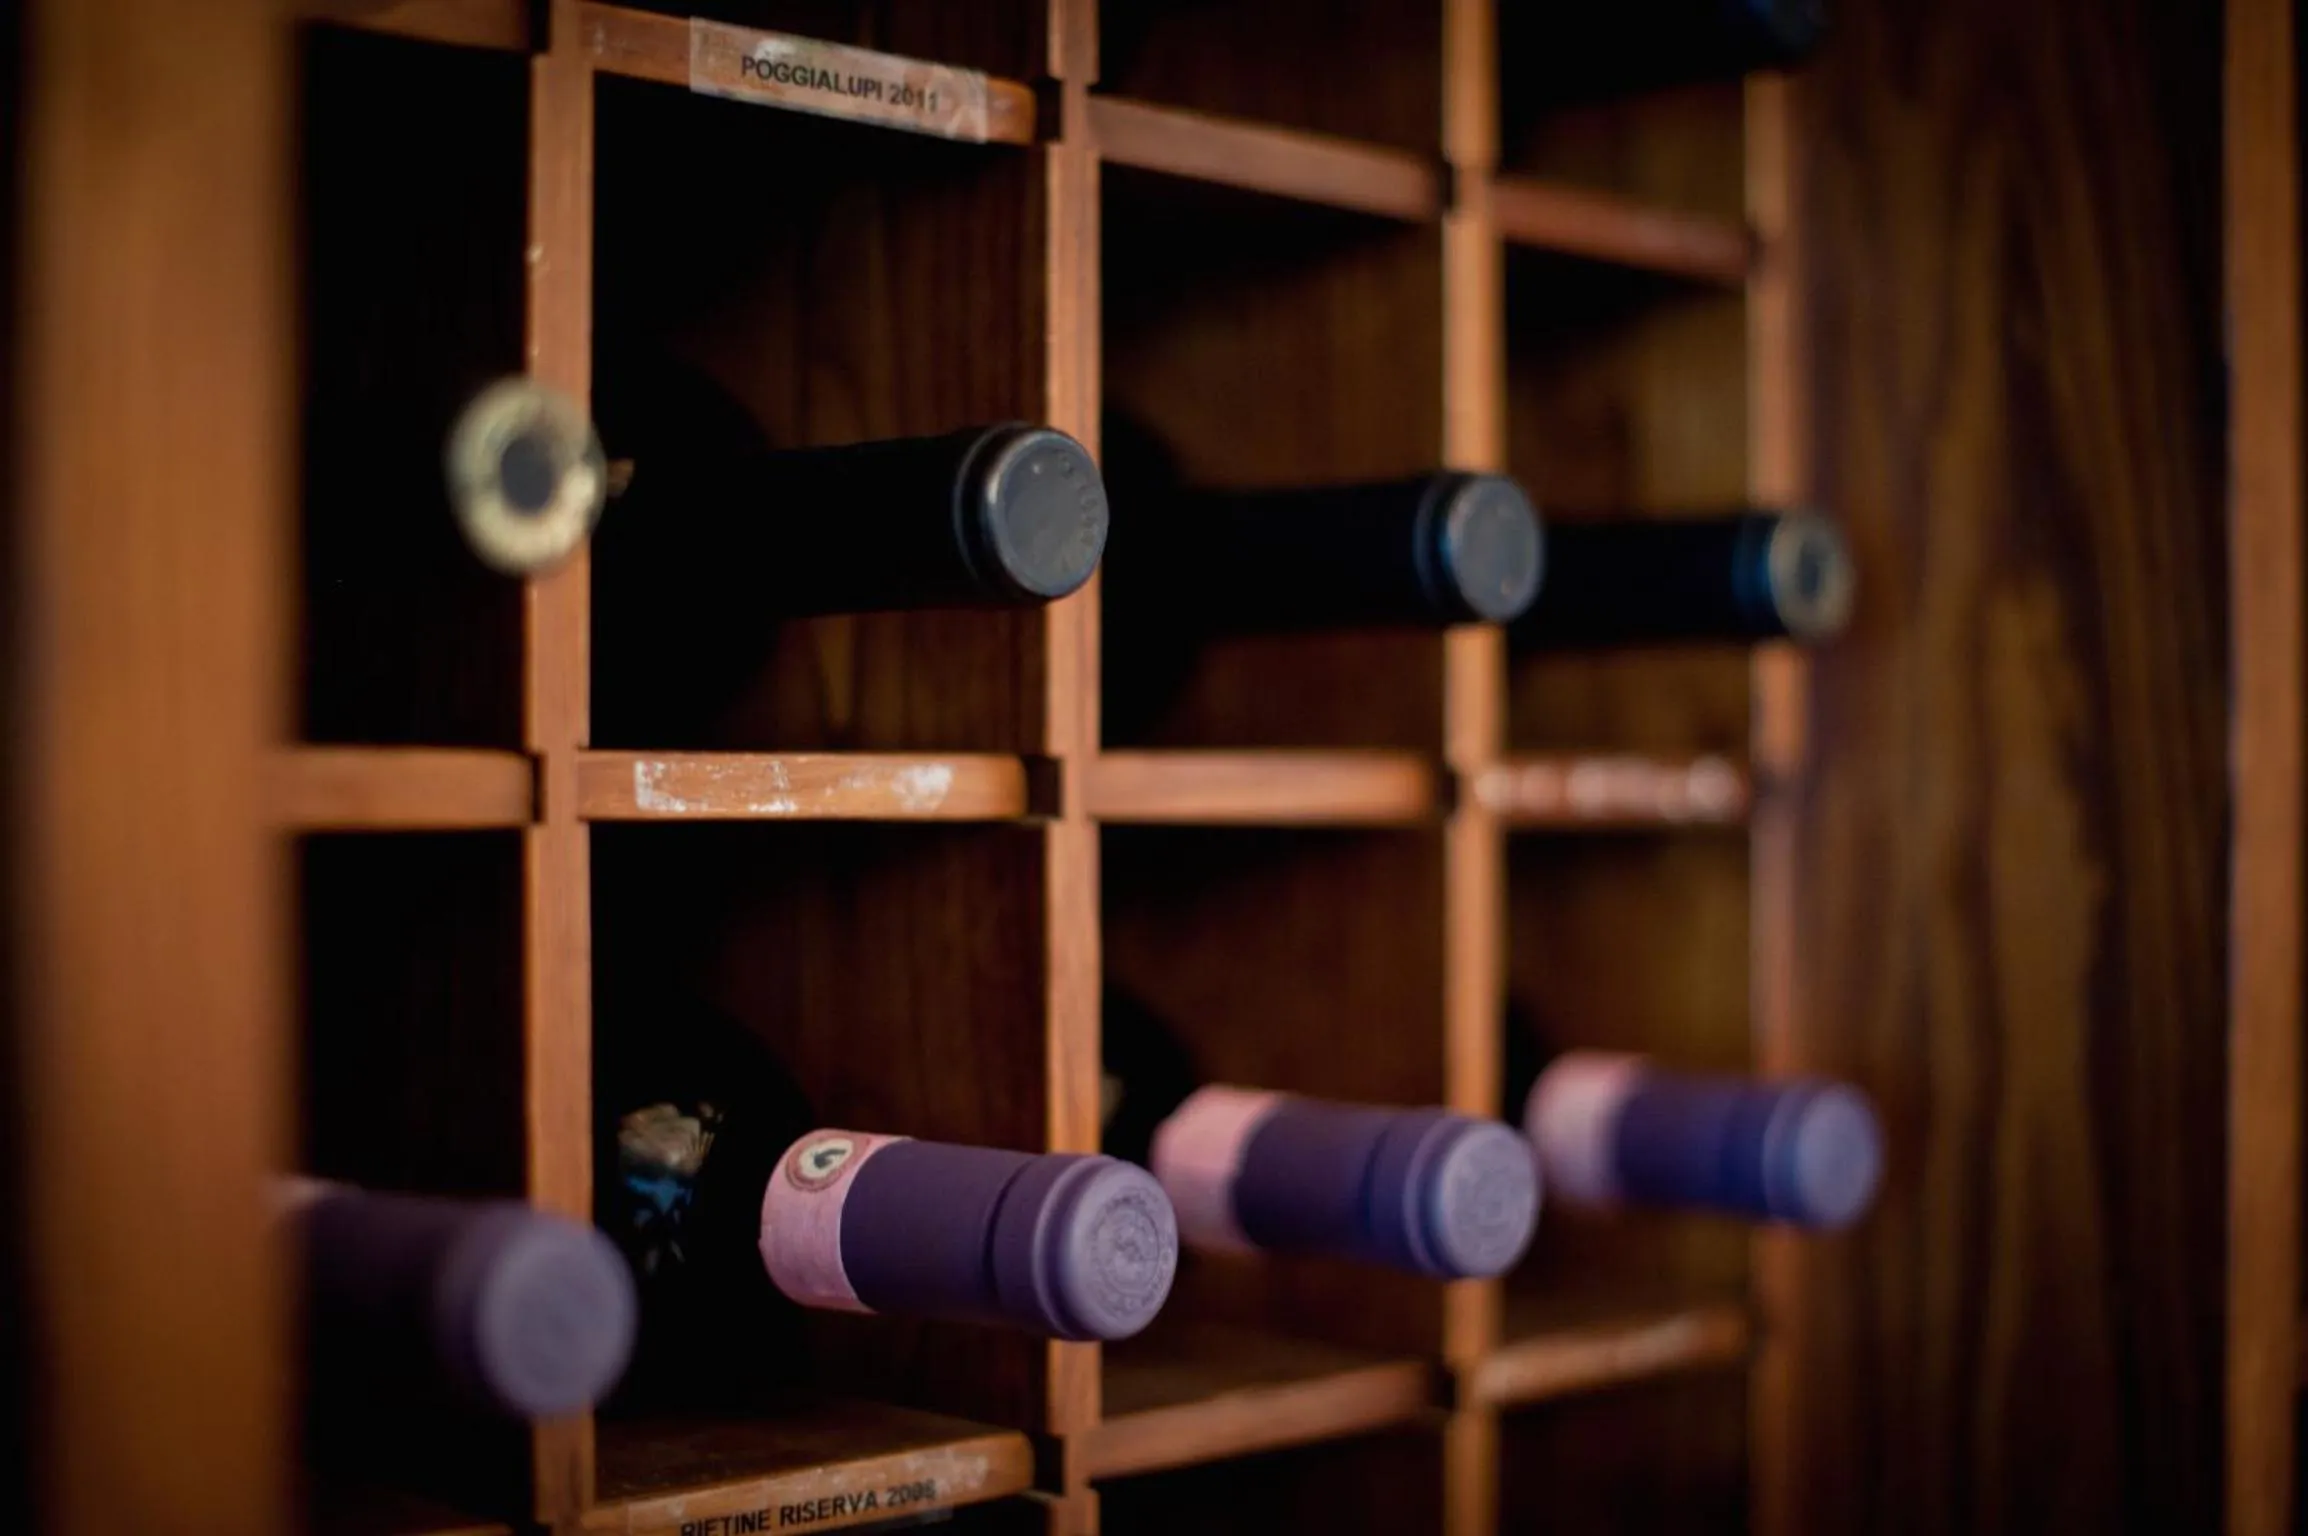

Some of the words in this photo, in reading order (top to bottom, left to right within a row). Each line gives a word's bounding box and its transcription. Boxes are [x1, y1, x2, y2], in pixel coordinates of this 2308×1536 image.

[741, 55, 882, 100] POGGIALUPI
[889, 83, 938, 111] 2011
[779, 1490, 879, 1528] RISERVA
